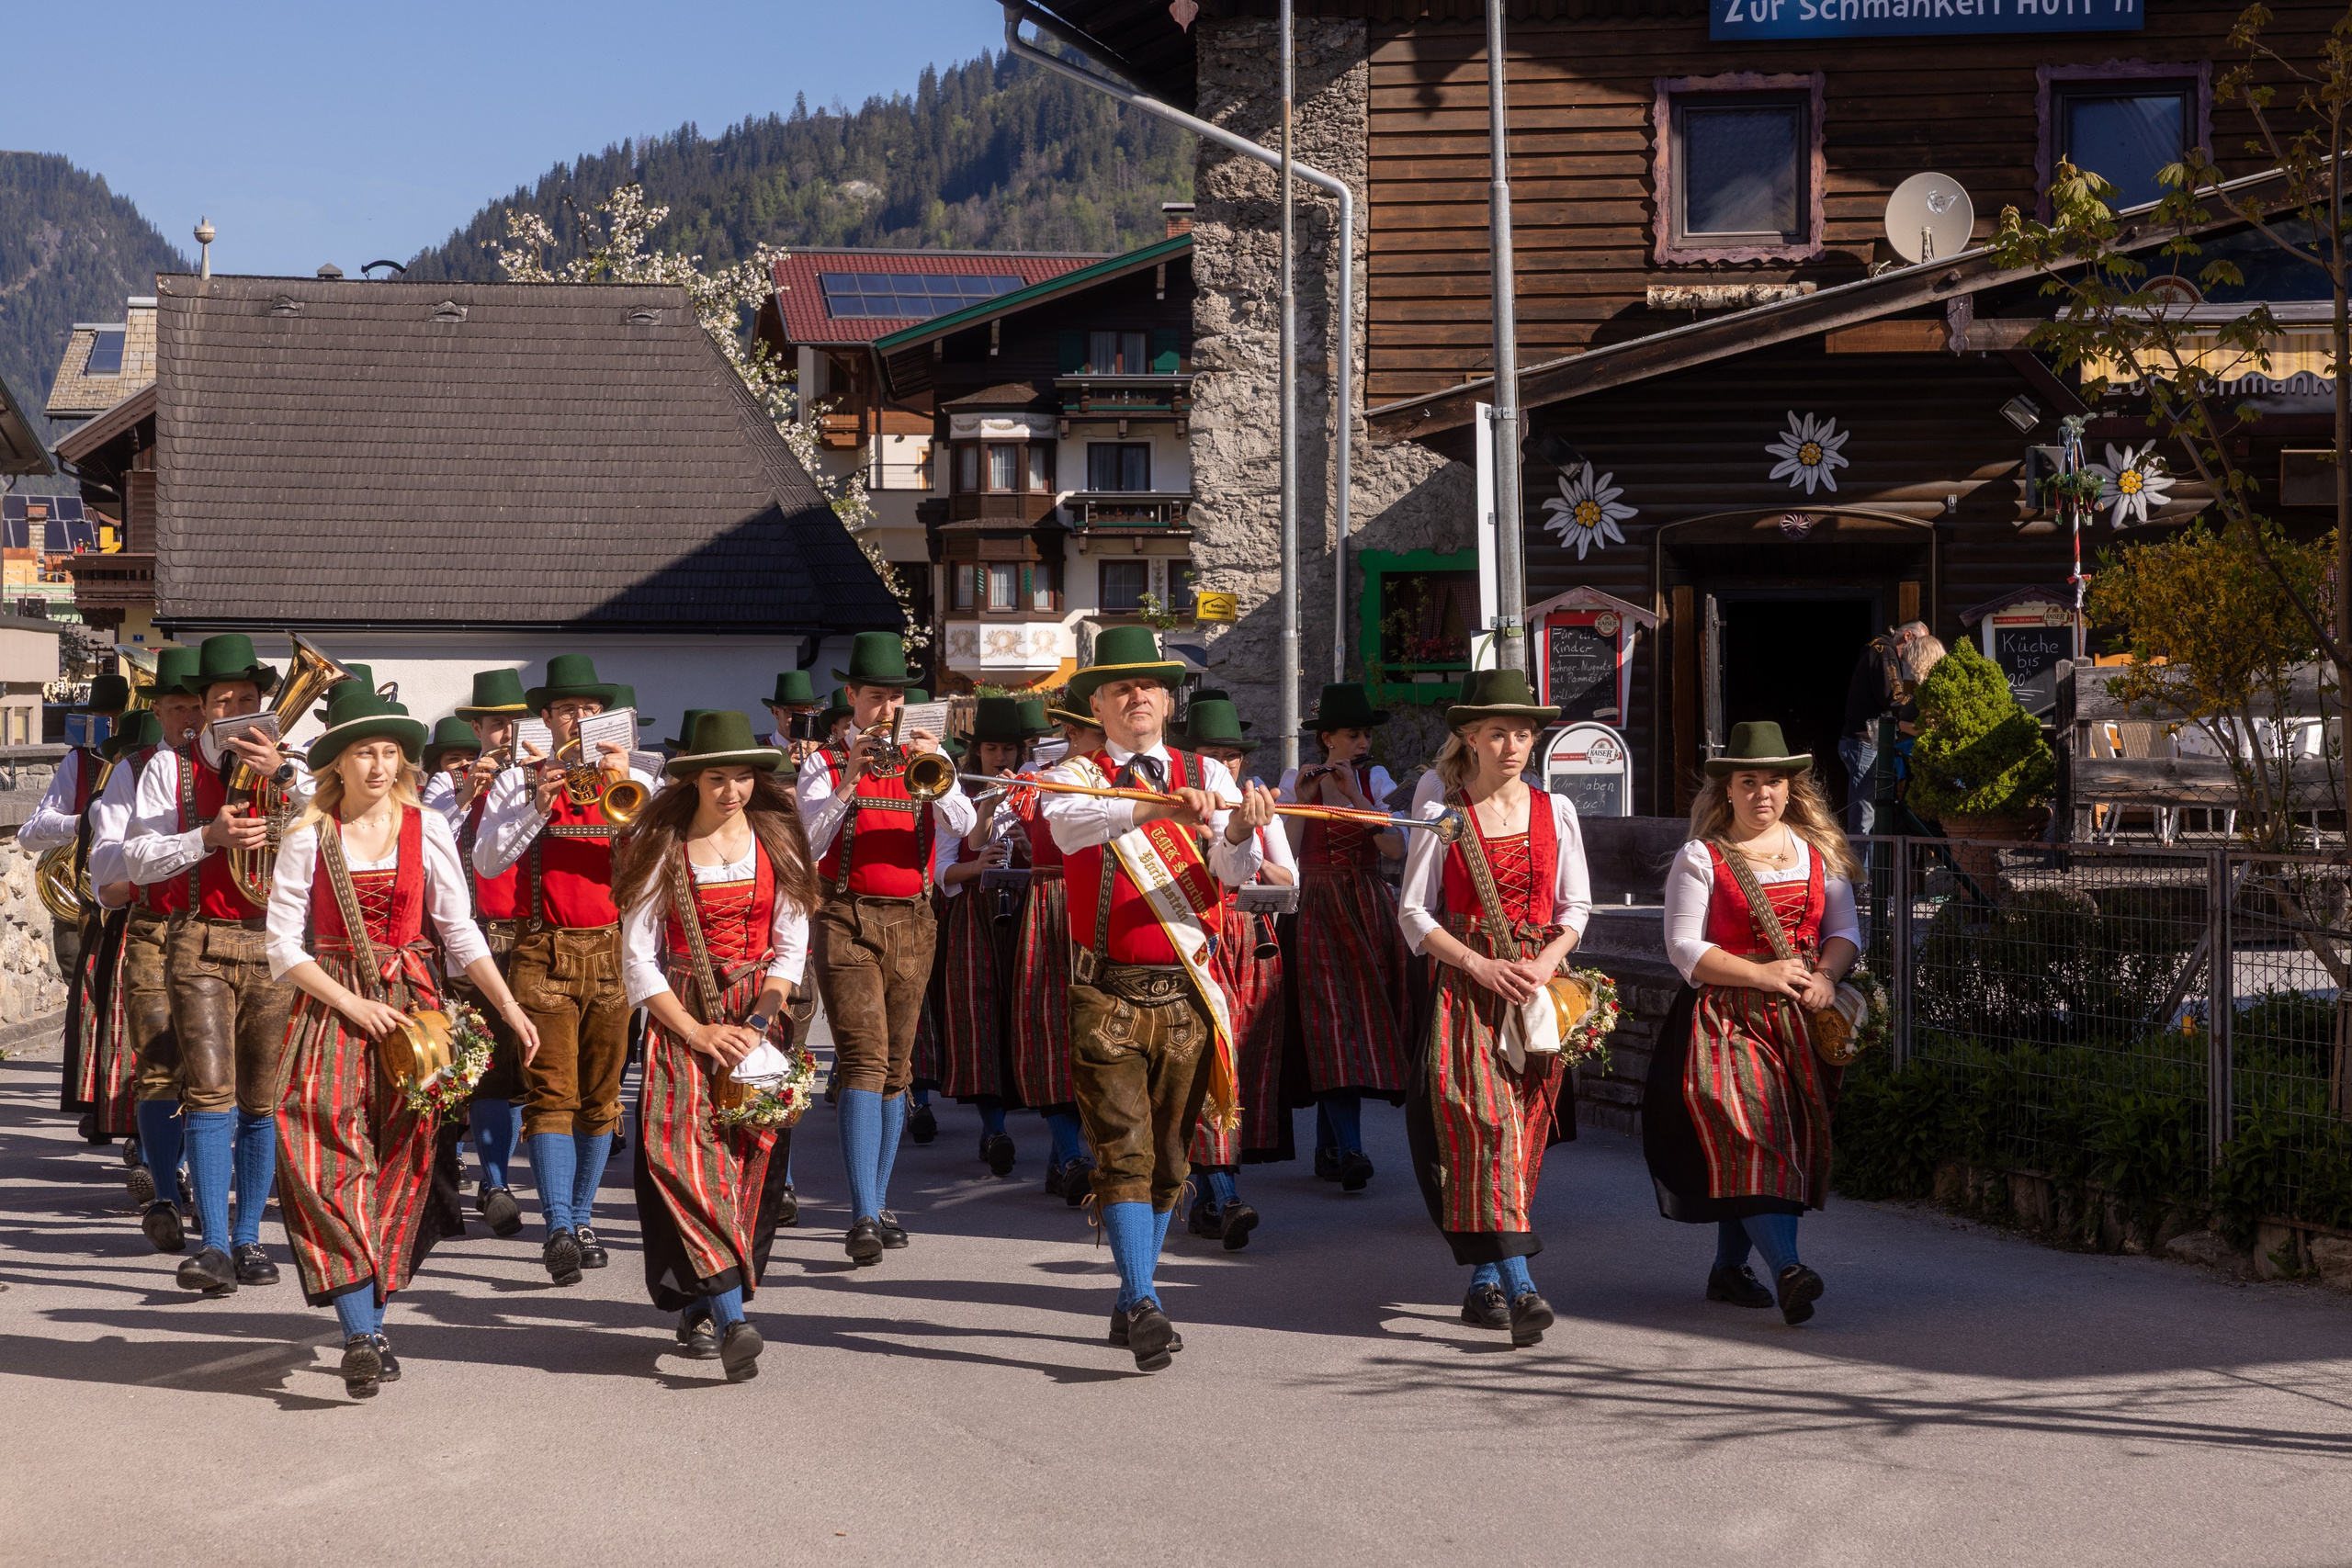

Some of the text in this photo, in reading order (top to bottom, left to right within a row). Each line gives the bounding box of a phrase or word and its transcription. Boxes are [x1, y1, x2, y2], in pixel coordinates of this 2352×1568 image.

[2177, 372, 2337, 397] chmank
[2045, 613, 2065, 621] KAISER
[1552, 627, 1599, 640] Für die
[1553, 640, 1594, 654] Kinder
[2003, 633, 2059, 654] Küche
[2017, 655, 2041, 668] bis
[1589, 749, 1612, 758] KAISER
[1578, 777, 1615, 793] haben
[1574, 793, 1606, 809] Euch
[1138, 849, 1189, 922] Dorfgastein
